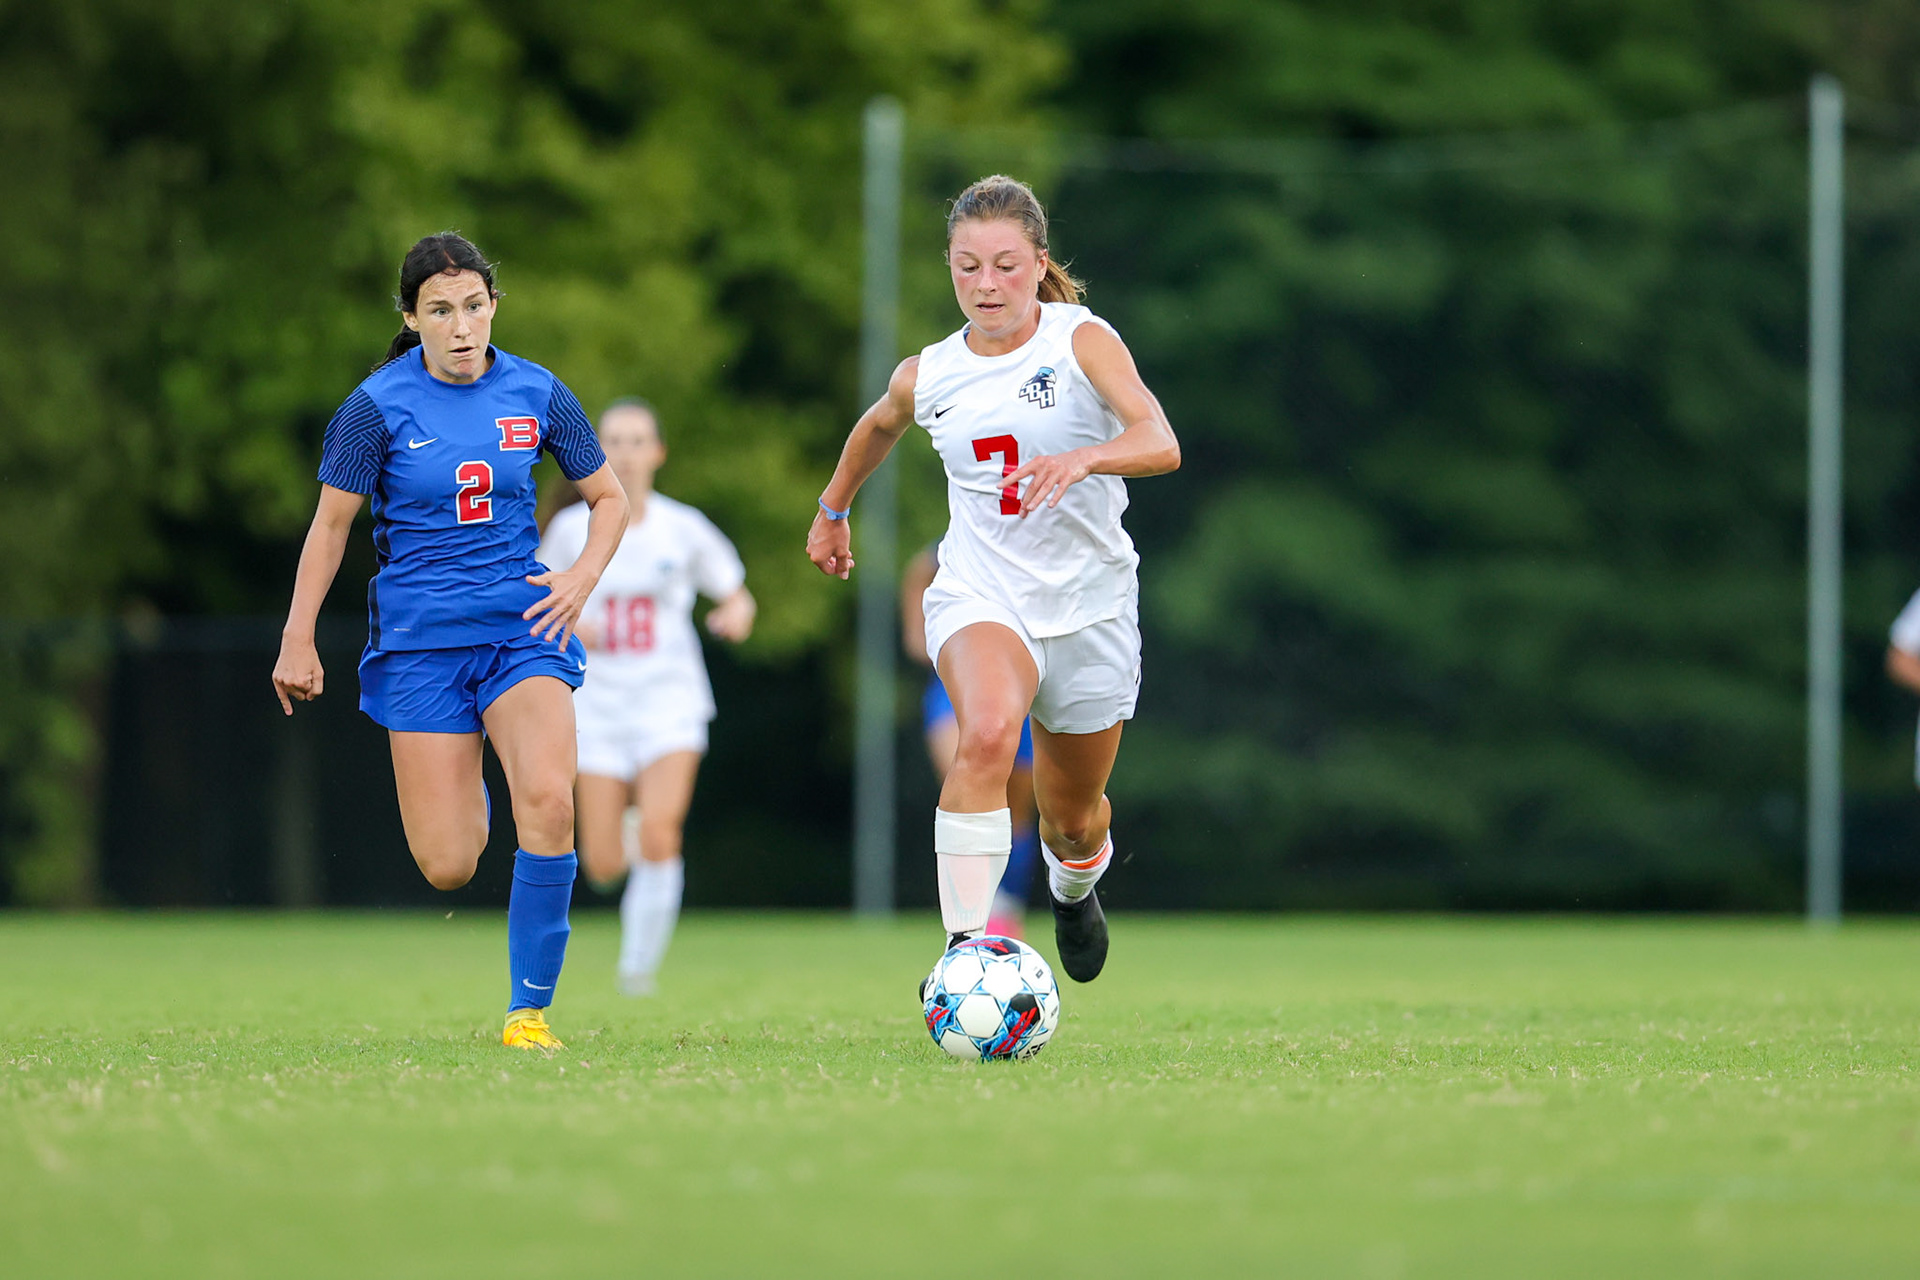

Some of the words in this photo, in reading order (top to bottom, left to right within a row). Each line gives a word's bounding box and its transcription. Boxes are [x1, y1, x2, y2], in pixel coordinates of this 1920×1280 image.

[495, 416, 541, 451] B
[455, 459, 494, 524] 2
[971, 434, 1021, 515] 7
[604, 595, 656, 654] 18
